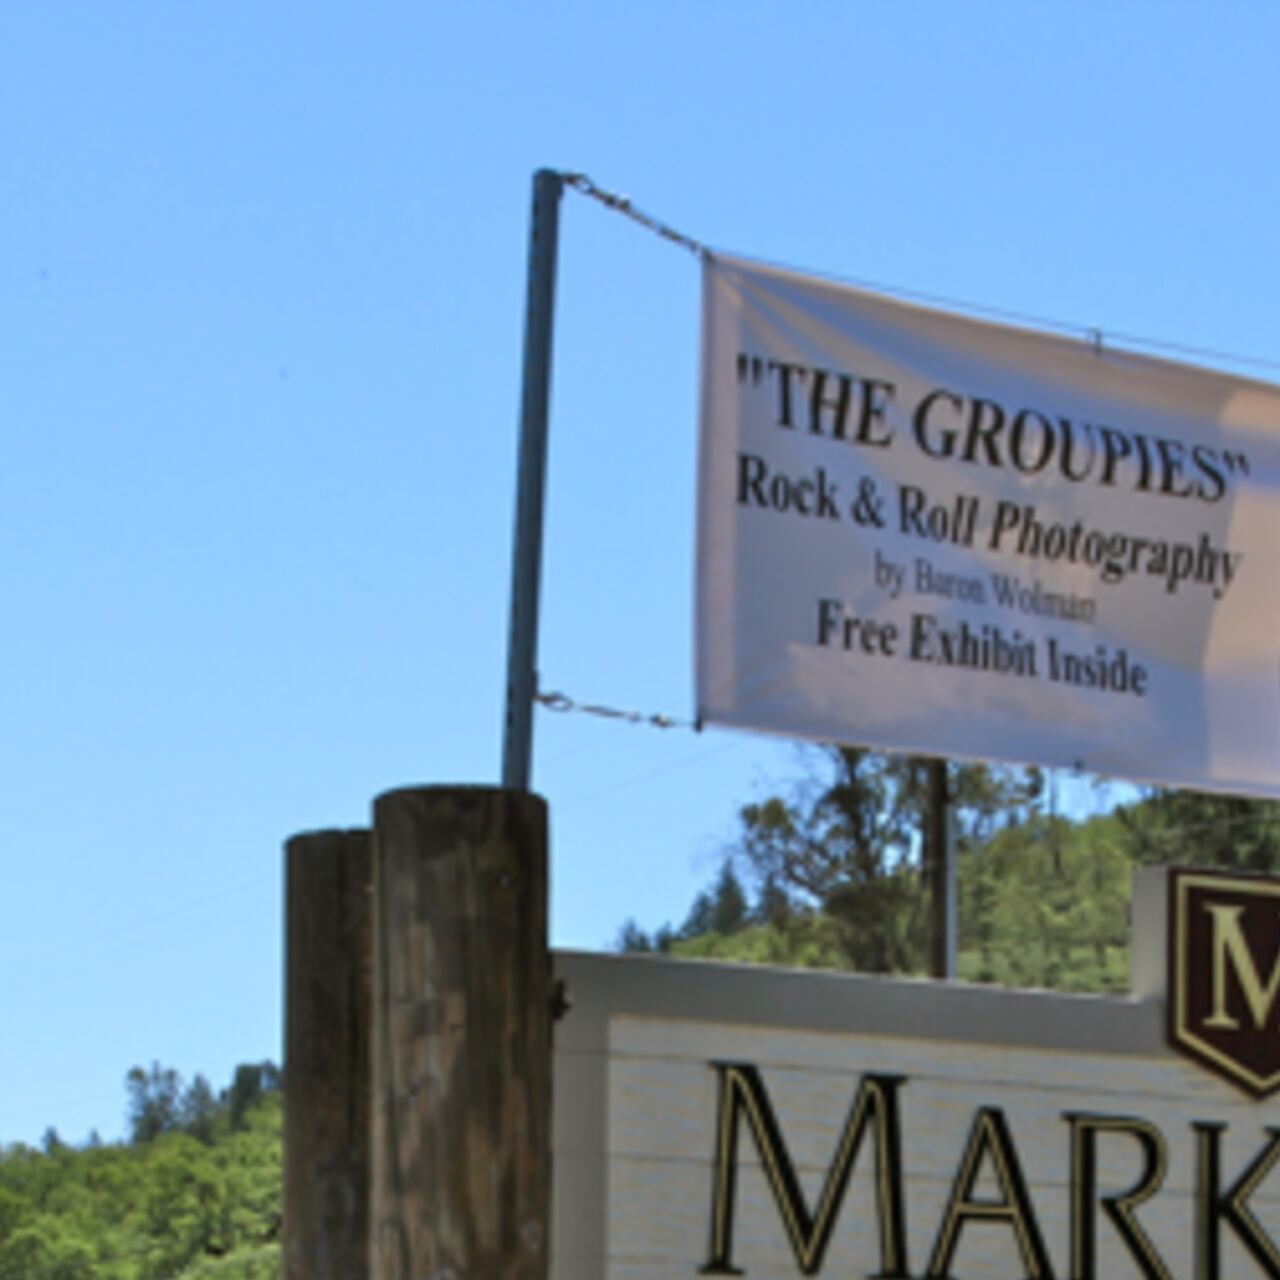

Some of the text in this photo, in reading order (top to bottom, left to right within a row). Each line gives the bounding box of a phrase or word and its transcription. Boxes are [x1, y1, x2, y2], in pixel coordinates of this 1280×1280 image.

[736, 352, 1252, 503] "THE GROUPIES"
[737, 453, 840, 521] Rock
[850, 475, 886, 529] &
[898, 484, 980, 547] Roll
[987, 498, 1244, 600] Photography
[874, 549, 904, 599] by
[816, 597, 1148, 697] Free Exhibit Inside
